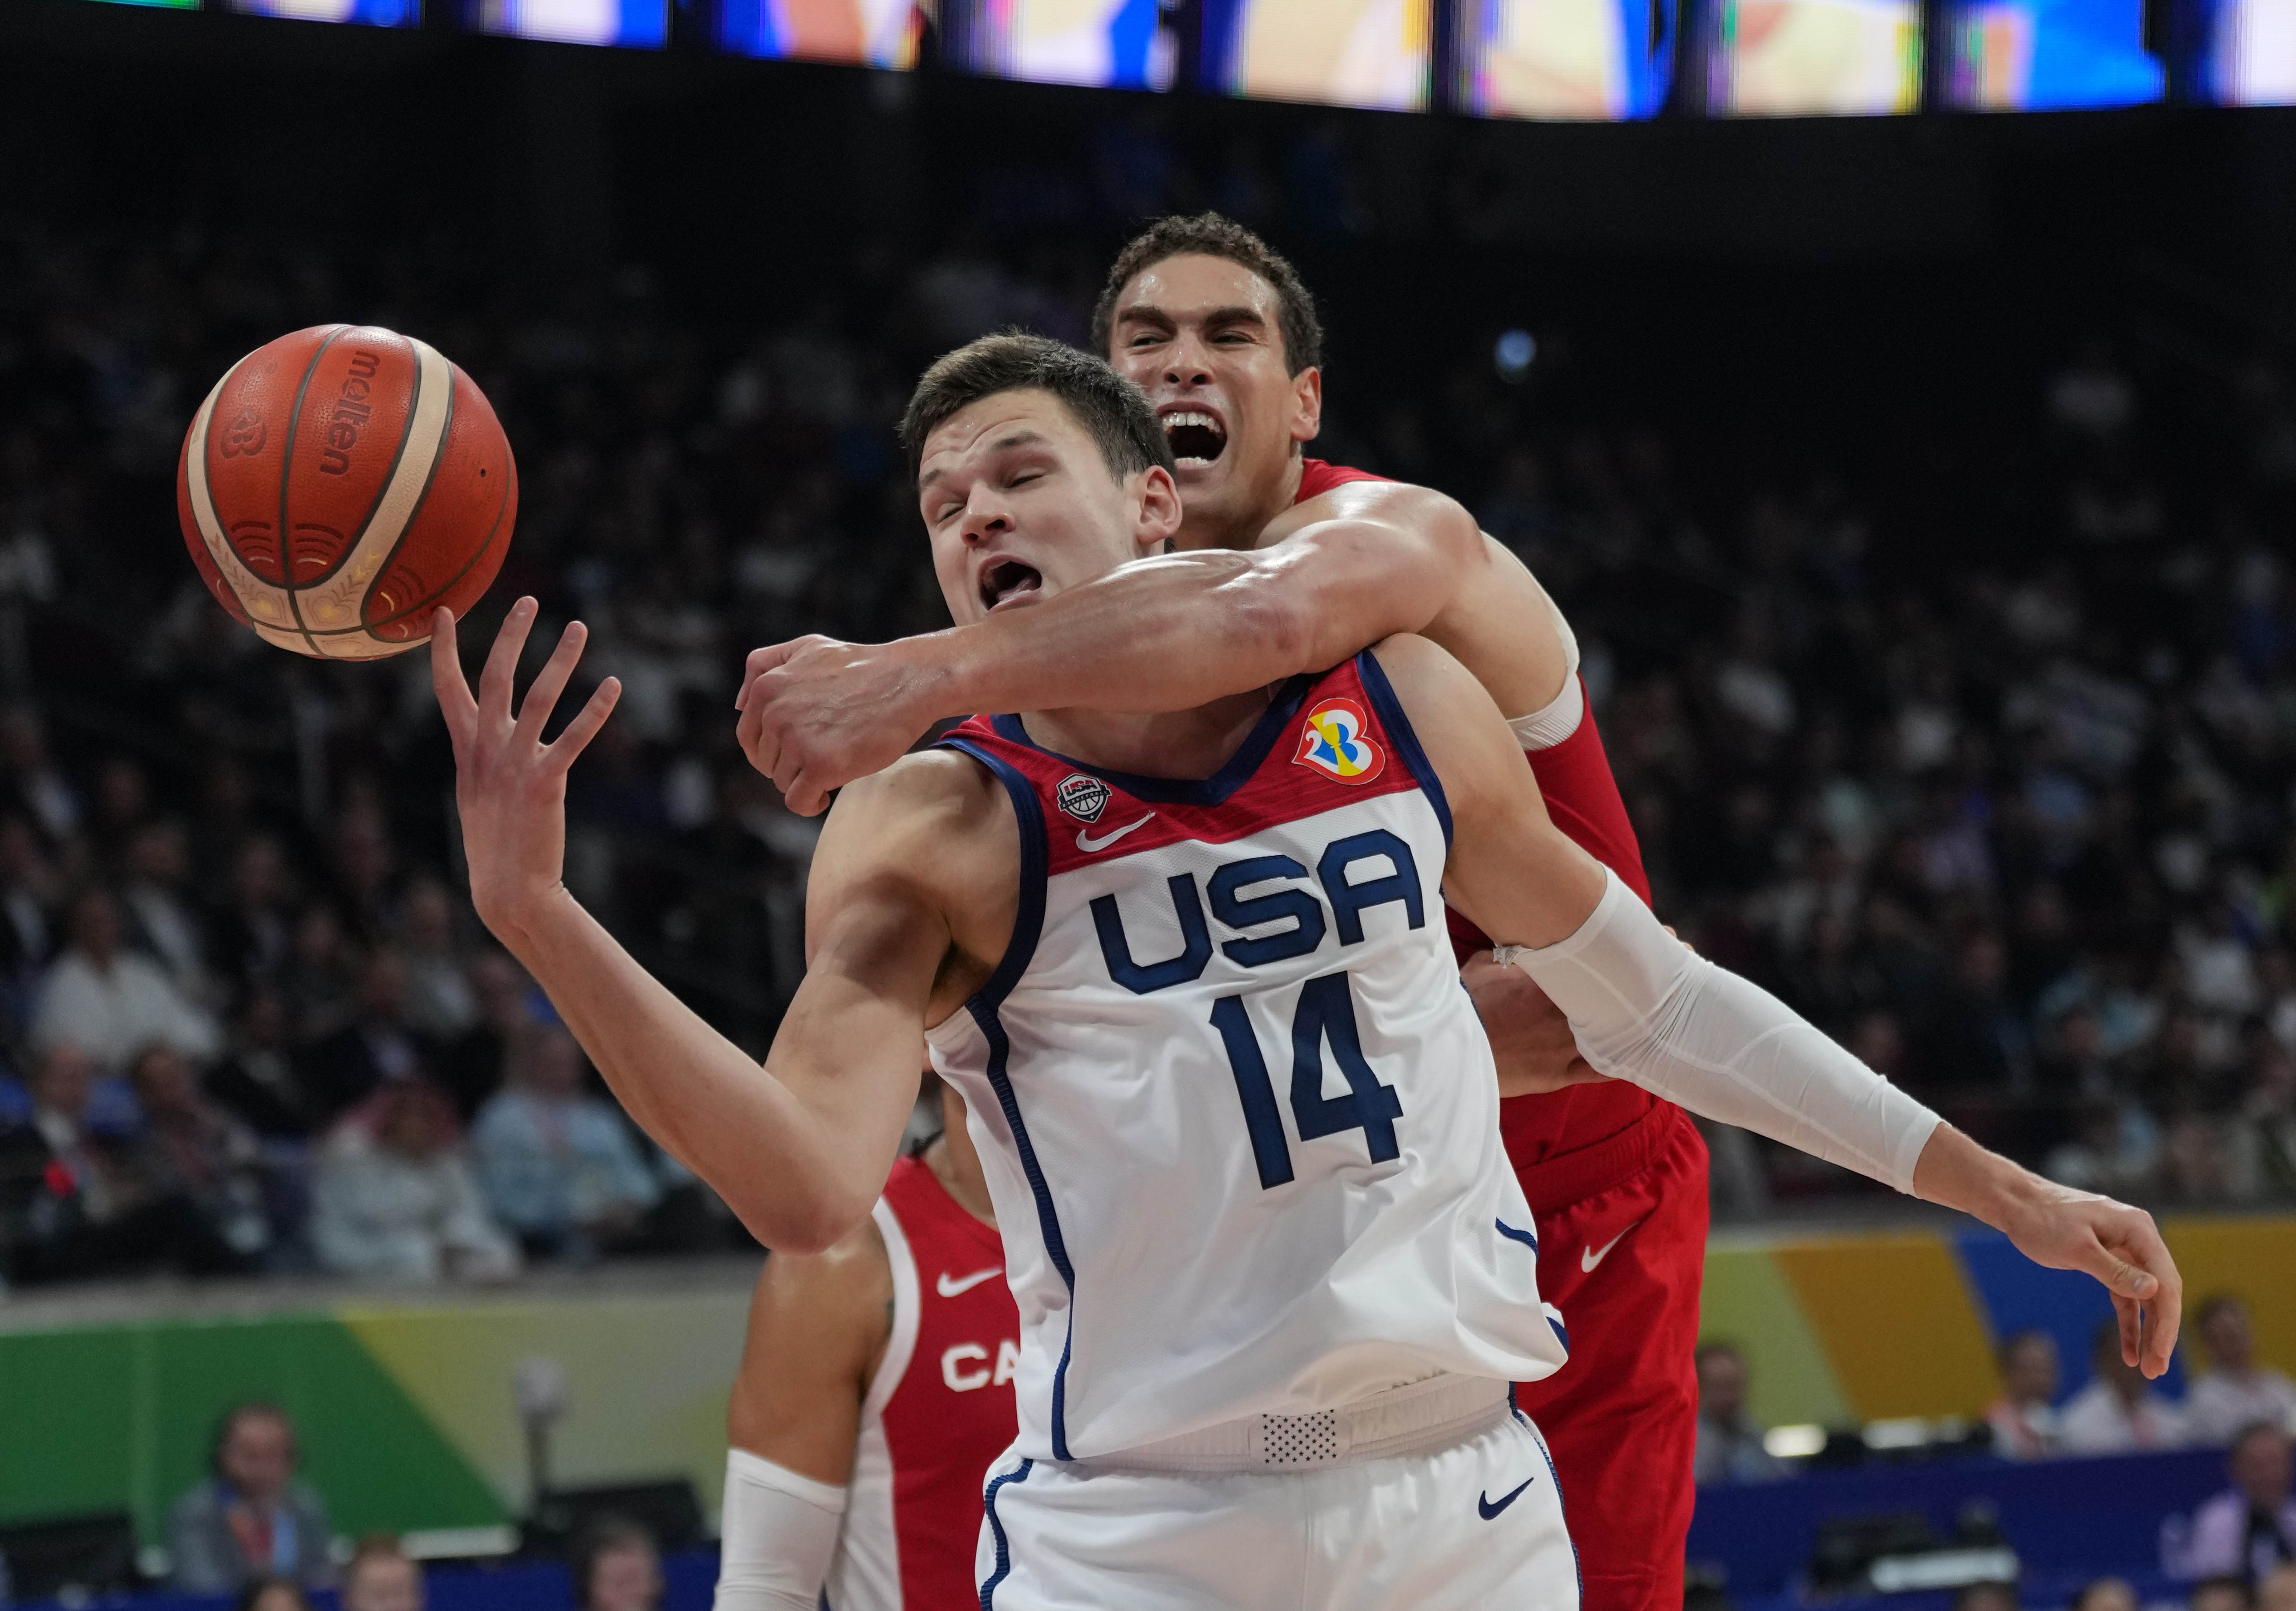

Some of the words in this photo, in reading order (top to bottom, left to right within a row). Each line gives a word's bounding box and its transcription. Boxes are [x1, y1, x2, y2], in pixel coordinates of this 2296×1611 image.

[320, 350, 380, 476] molten
[1062, 790, 1108, 808] BASKETBALL
[1064, 780, 1097, 797] USA
[1089, 829, 1424, 995] USA
[1209, 970, 1403, 1190] 14
